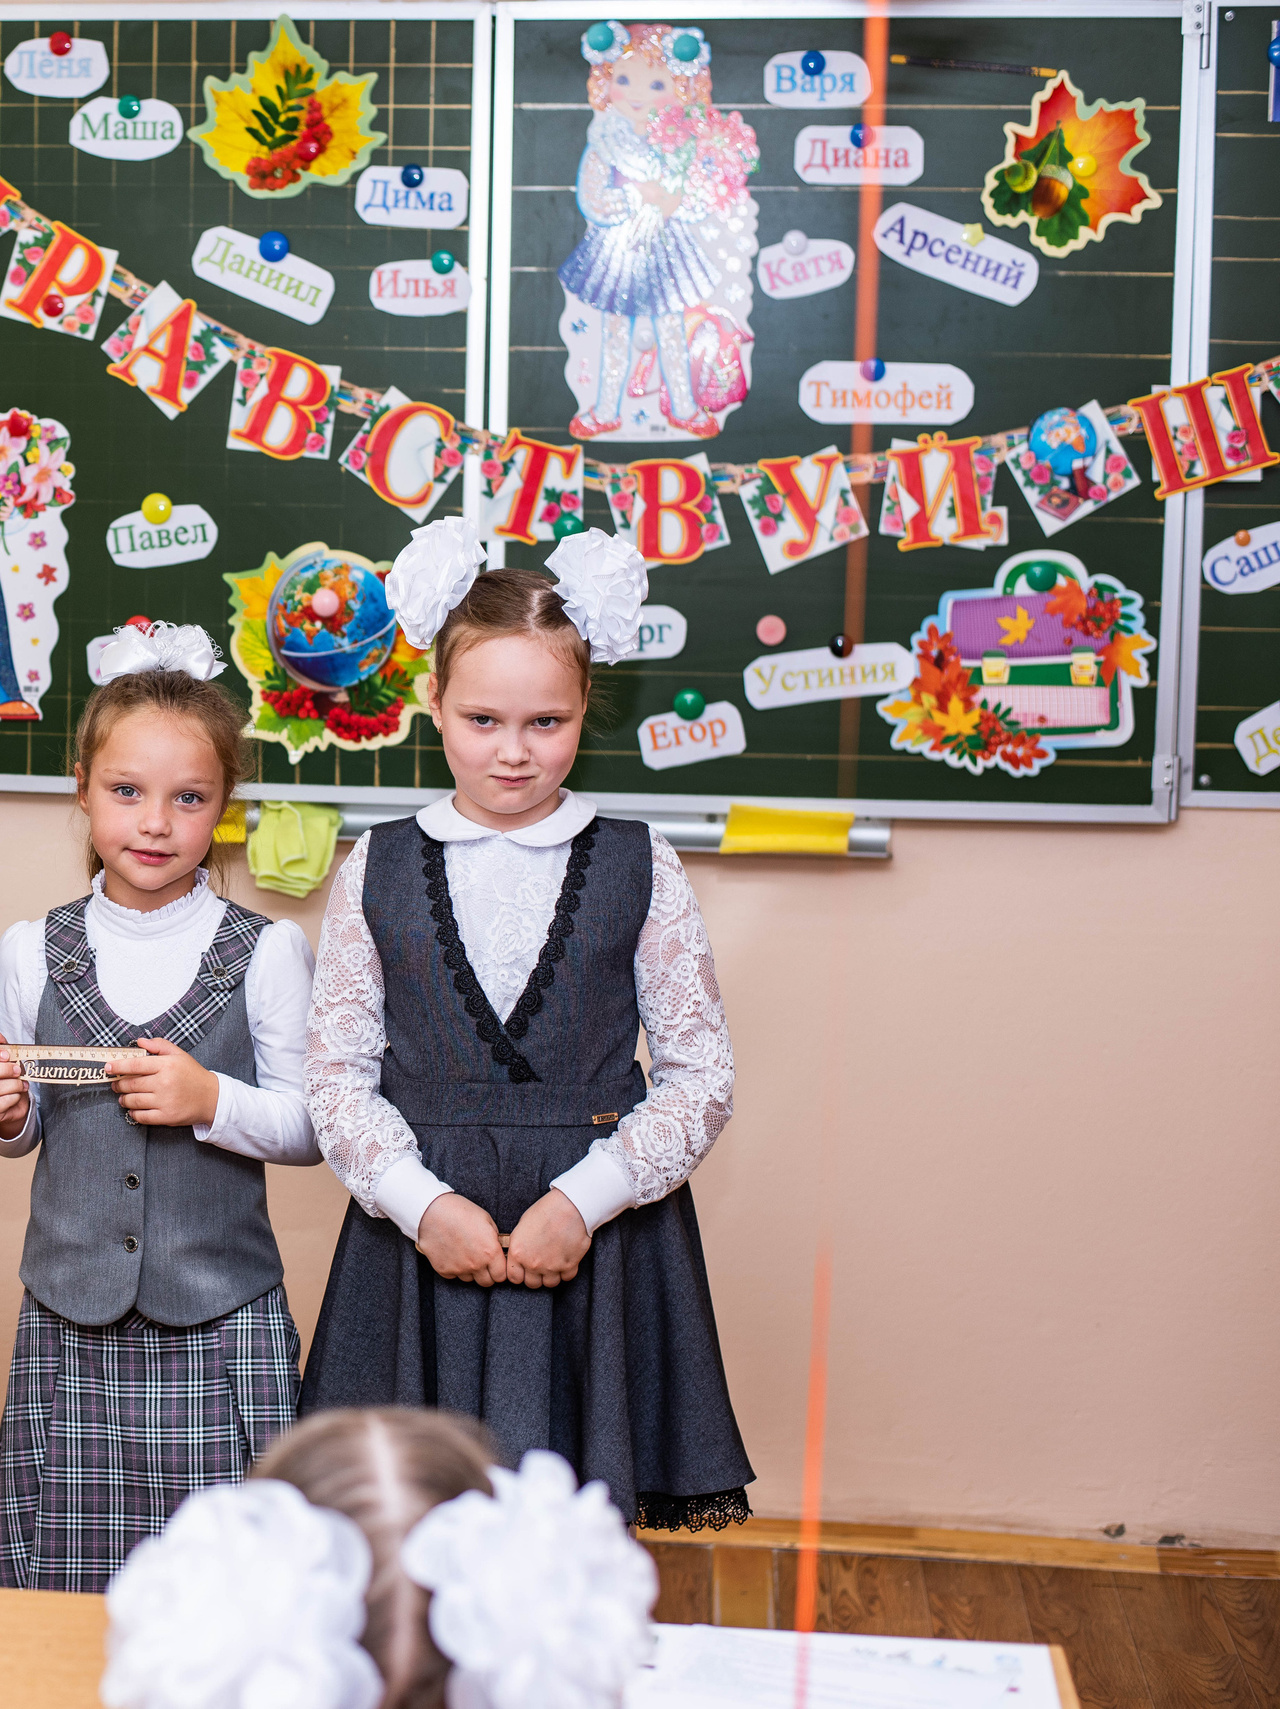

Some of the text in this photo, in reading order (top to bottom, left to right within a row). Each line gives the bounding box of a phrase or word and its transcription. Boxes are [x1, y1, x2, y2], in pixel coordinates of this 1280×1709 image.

[12, 49, 92, 80] Лёня
[772, 66, 857, 101] Варя
[79, 112, 176, 141] Маша
[802, 138, 911, 173] Диана
[363, 180, 454, 214] Дима
[881, 214, 1025, 290] Арсений
[199, 236, 323, 308] Даниил
[375, 268, 457, 299] Илья
[763, 251, 846, 291] Катя
[808, 380, 954, 417] Тимофей
[108, 522, 208, 556] Павел
[753, 657, 898, 696] Устиния
[647, 715, 727, 754] Егор
[23, 1059, 108, 1084] Виктория
